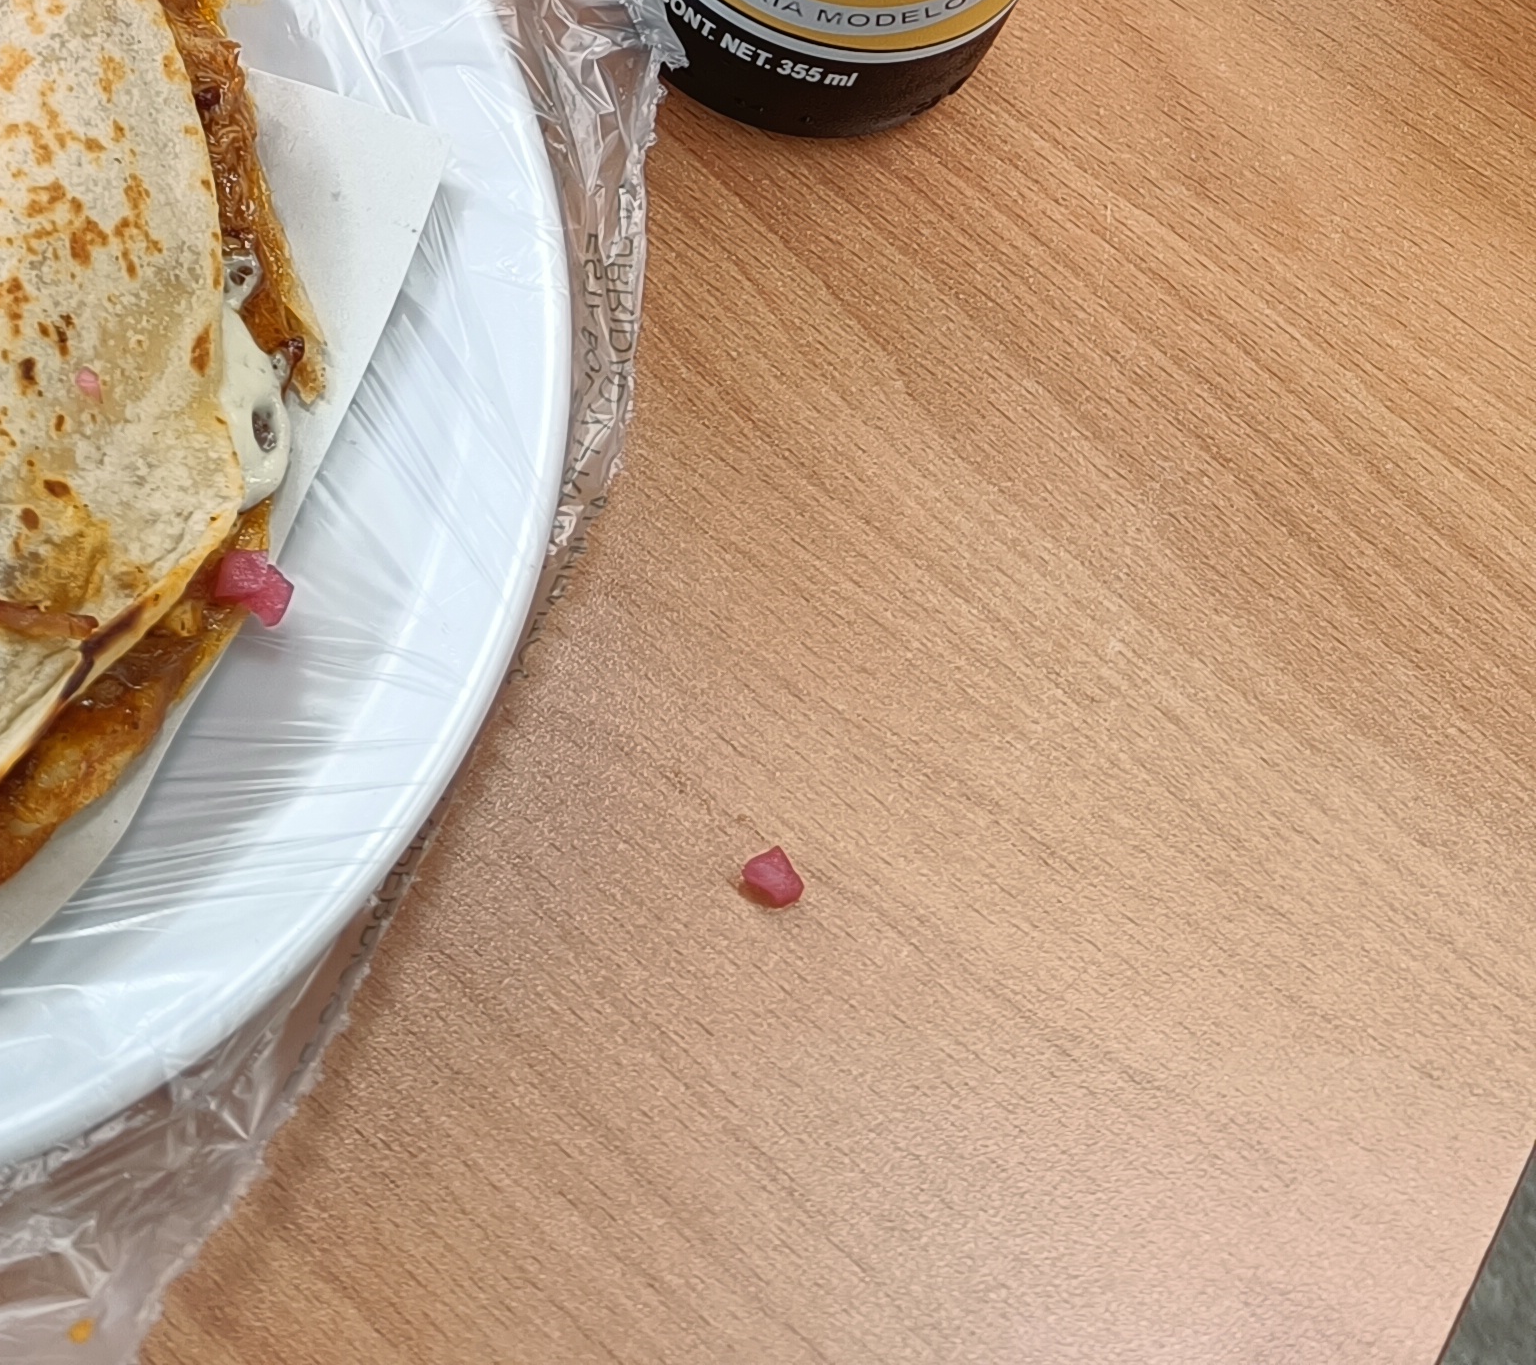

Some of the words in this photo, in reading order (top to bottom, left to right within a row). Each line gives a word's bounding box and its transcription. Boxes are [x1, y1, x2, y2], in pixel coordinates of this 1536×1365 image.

[719, 32, 771, 70] NET.
[776, 58, 823, 84] 355
[823, 71, 860, 88] ml
